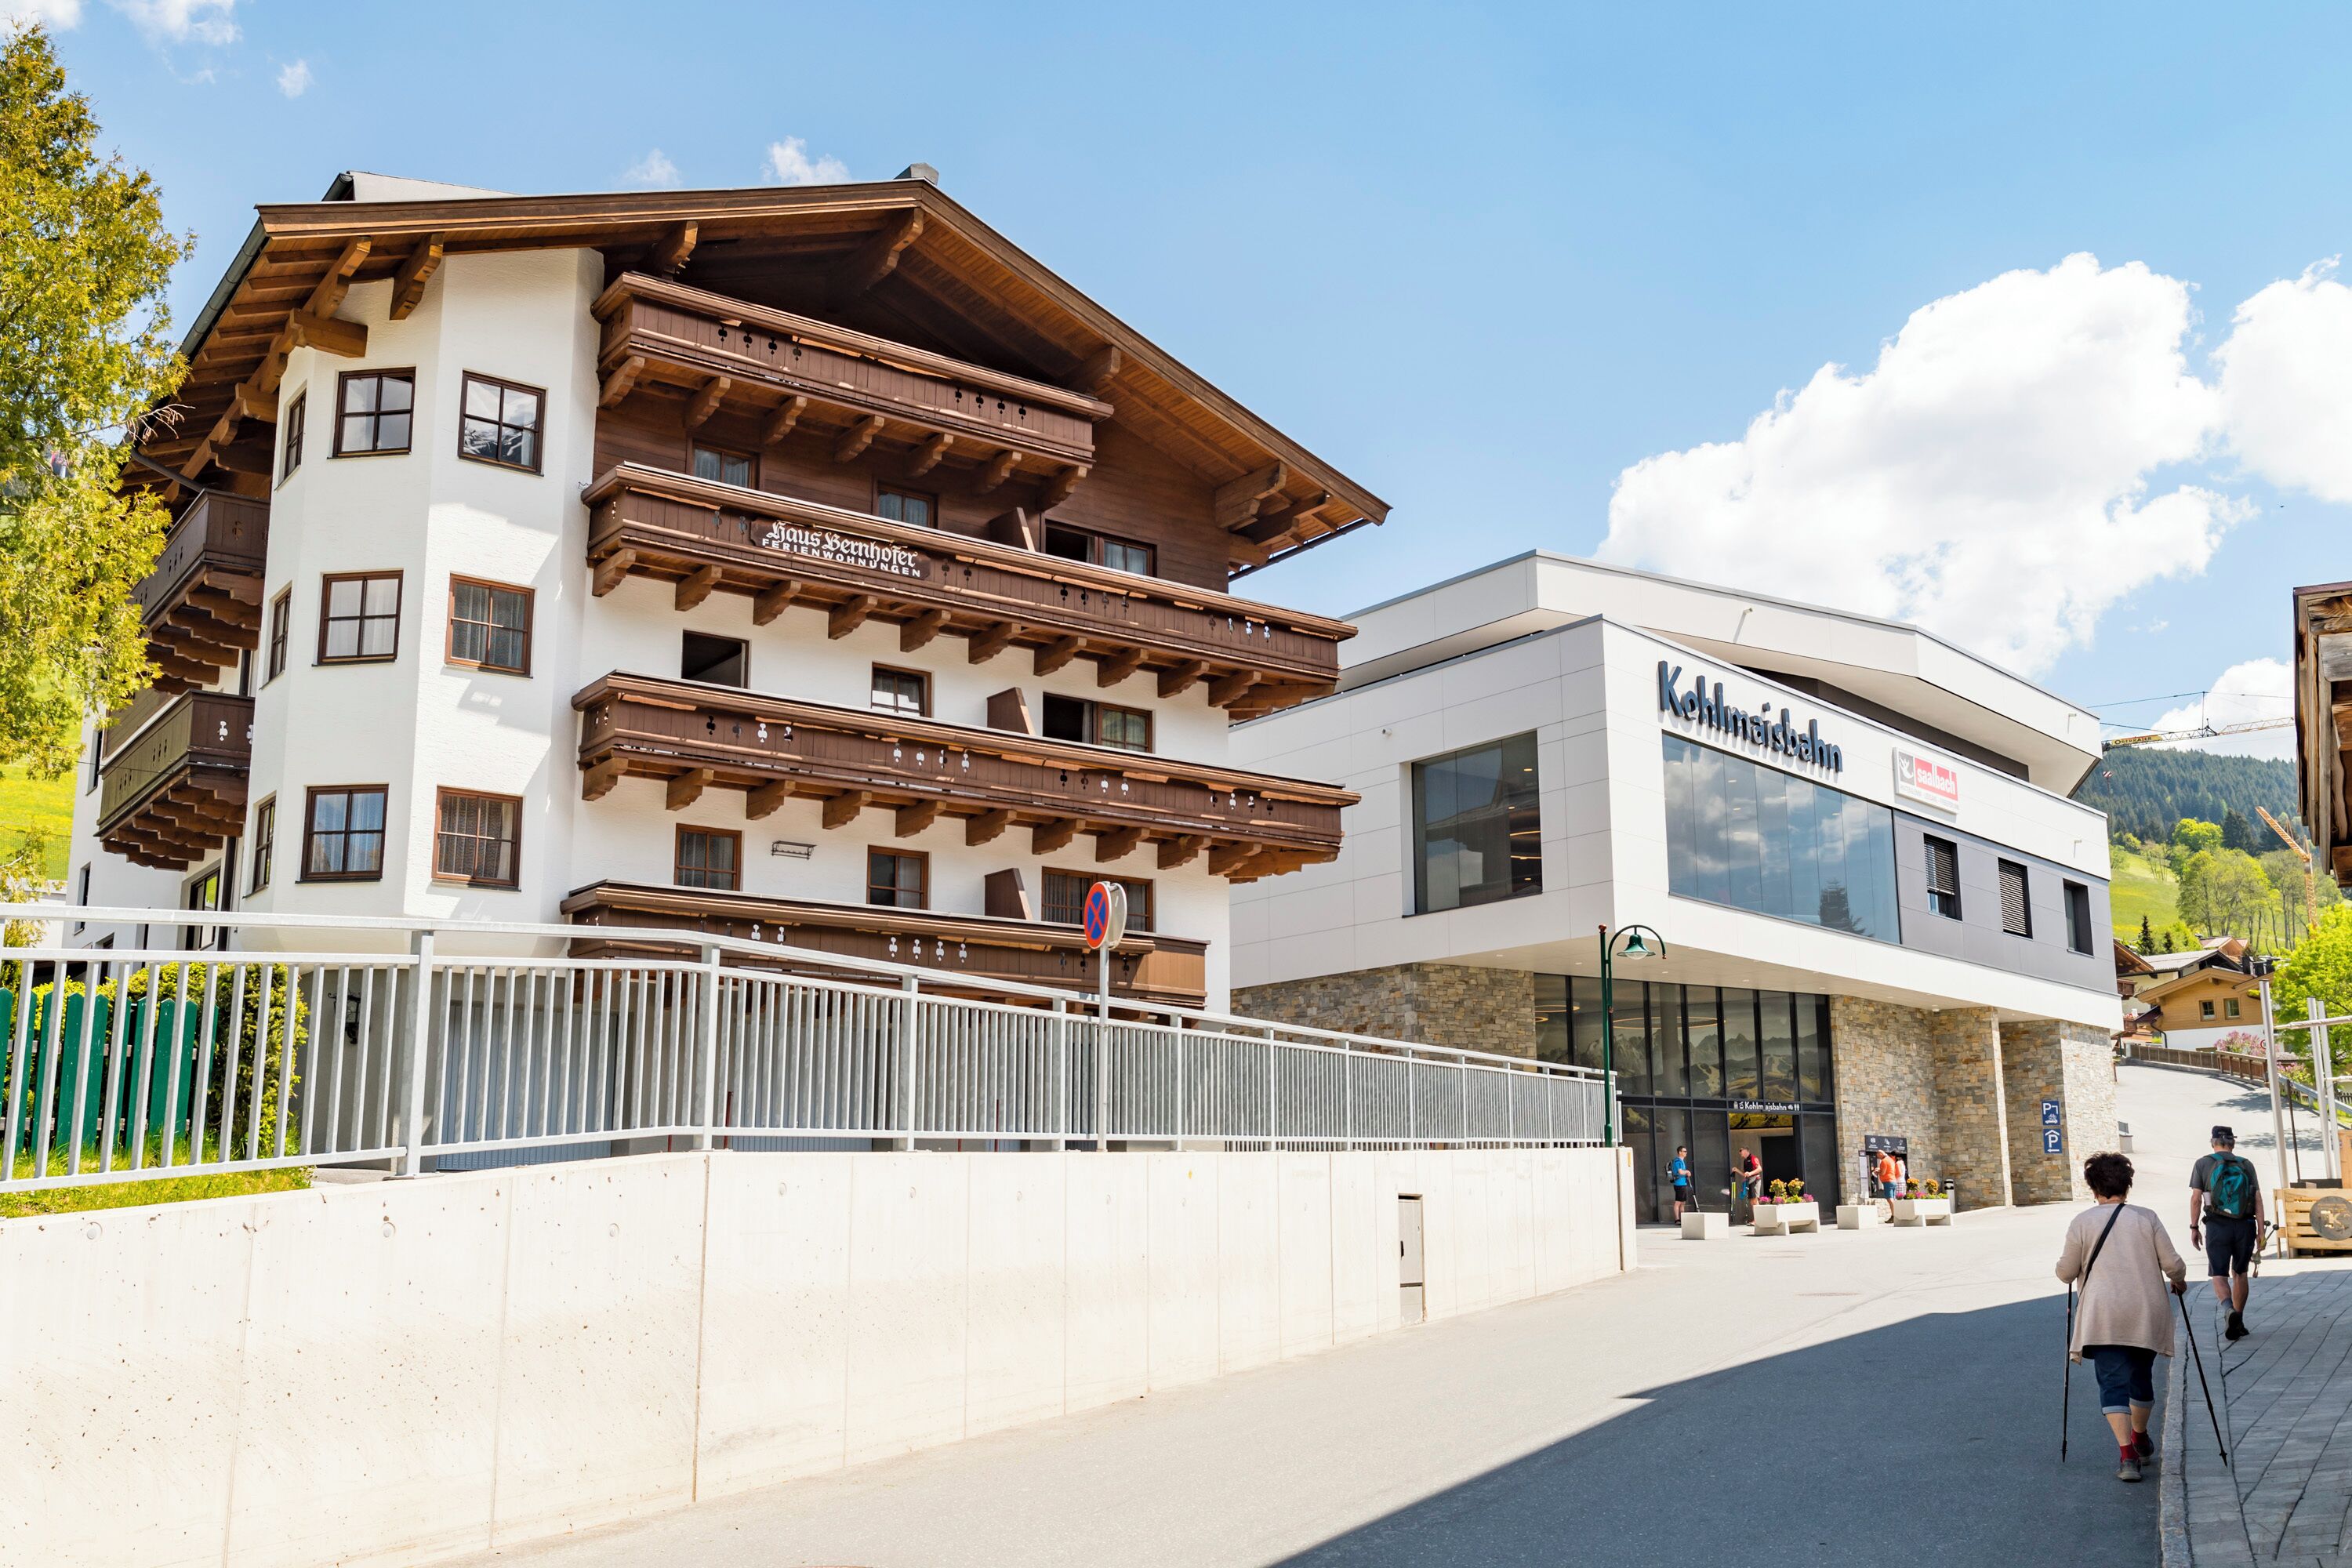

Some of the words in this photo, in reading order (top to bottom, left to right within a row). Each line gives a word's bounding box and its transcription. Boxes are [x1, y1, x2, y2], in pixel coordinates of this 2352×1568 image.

[761, 538, 921, 578] FERIENWOHNUNGEN
[765, 521, 822, 547] Haus
[822, 532, 918, 568] Bernhofer
[1657, 660, 1843, 773] Kohlmaisbahn
[1917, 762, 1957, 796] saalbach
[2042, 1102, 2052, 1115] P
[2048, 1134, 2059, 1148] P
